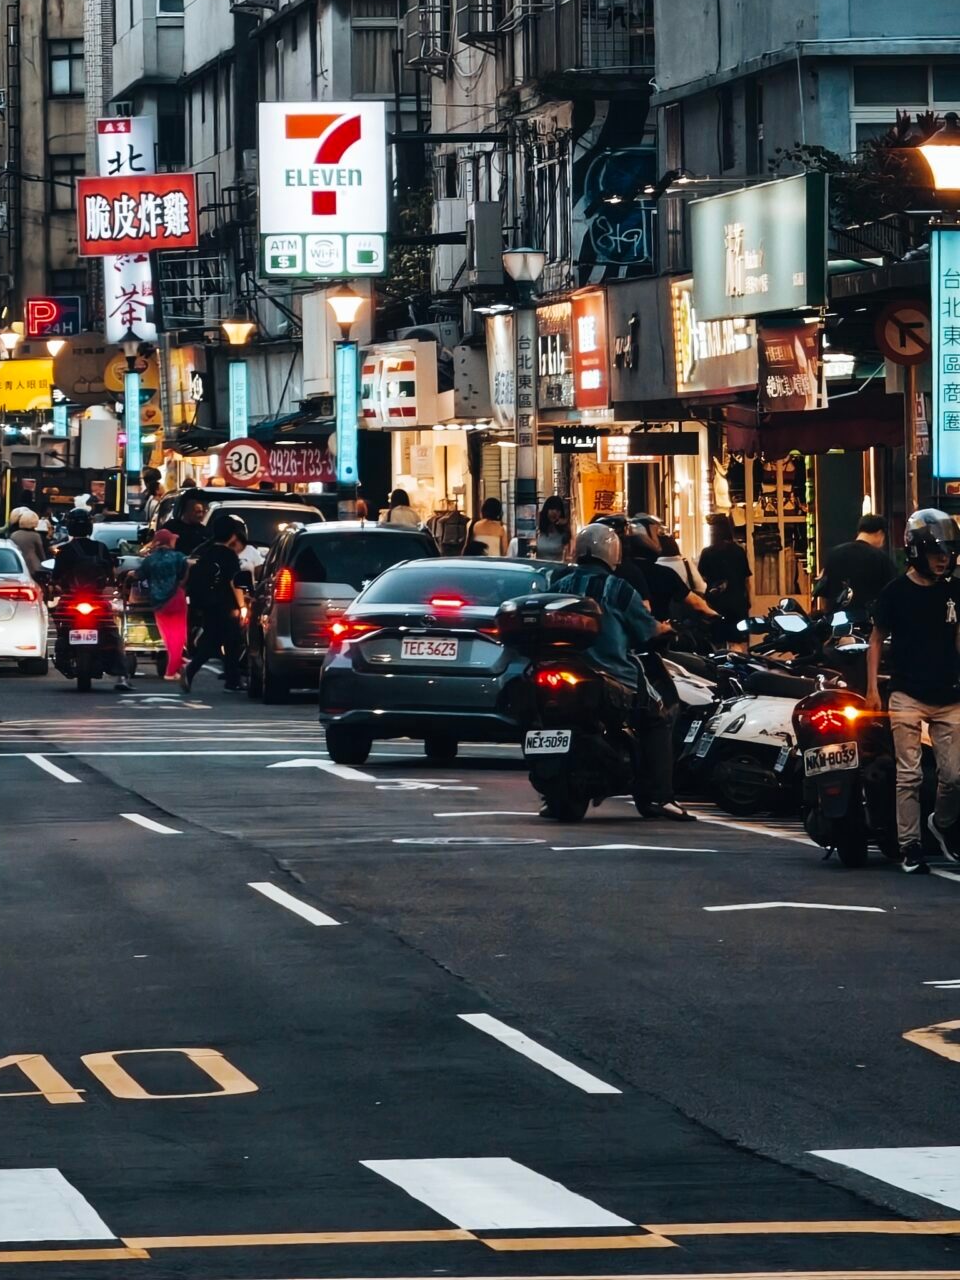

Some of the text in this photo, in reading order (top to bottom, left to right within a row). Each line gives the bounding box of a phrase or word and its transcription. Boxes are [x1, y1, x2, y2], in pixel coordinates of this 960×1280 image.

[85, 192, 189, 240] 脆皮炸雞
[271, 240, 297, 251] ATM
[310, 248, 339, 258] Wi-Fi
[28, 300, 57, 334] P
[43, 321, 73, 334] 24H
[230, 451, 258, 474] 30
[403, 641, 456, 657] TEC-3623
[526, 735, 568, 749] NEX-5098
